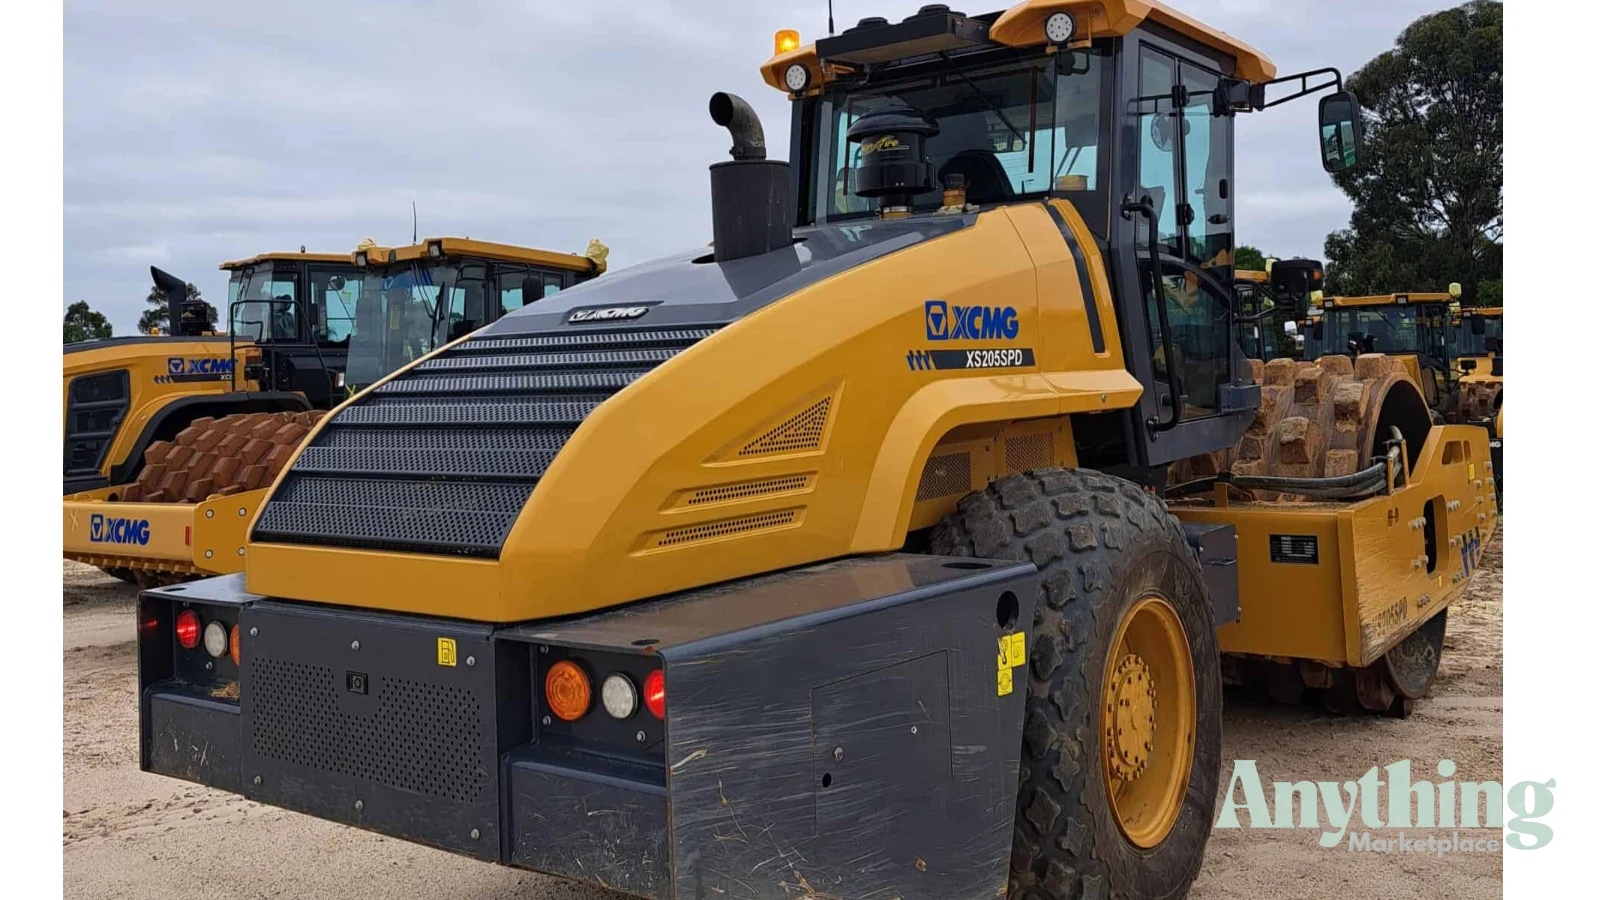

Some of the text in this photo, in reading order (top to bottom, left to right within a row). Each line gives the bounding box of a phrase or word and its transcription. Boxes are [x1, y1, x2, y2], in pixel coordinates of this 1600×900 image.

[950, 306, 1019, 340] XCMG
[966, 349, 1023, 368] XS205SPD
[104, 517, 150, 546] XCMG
